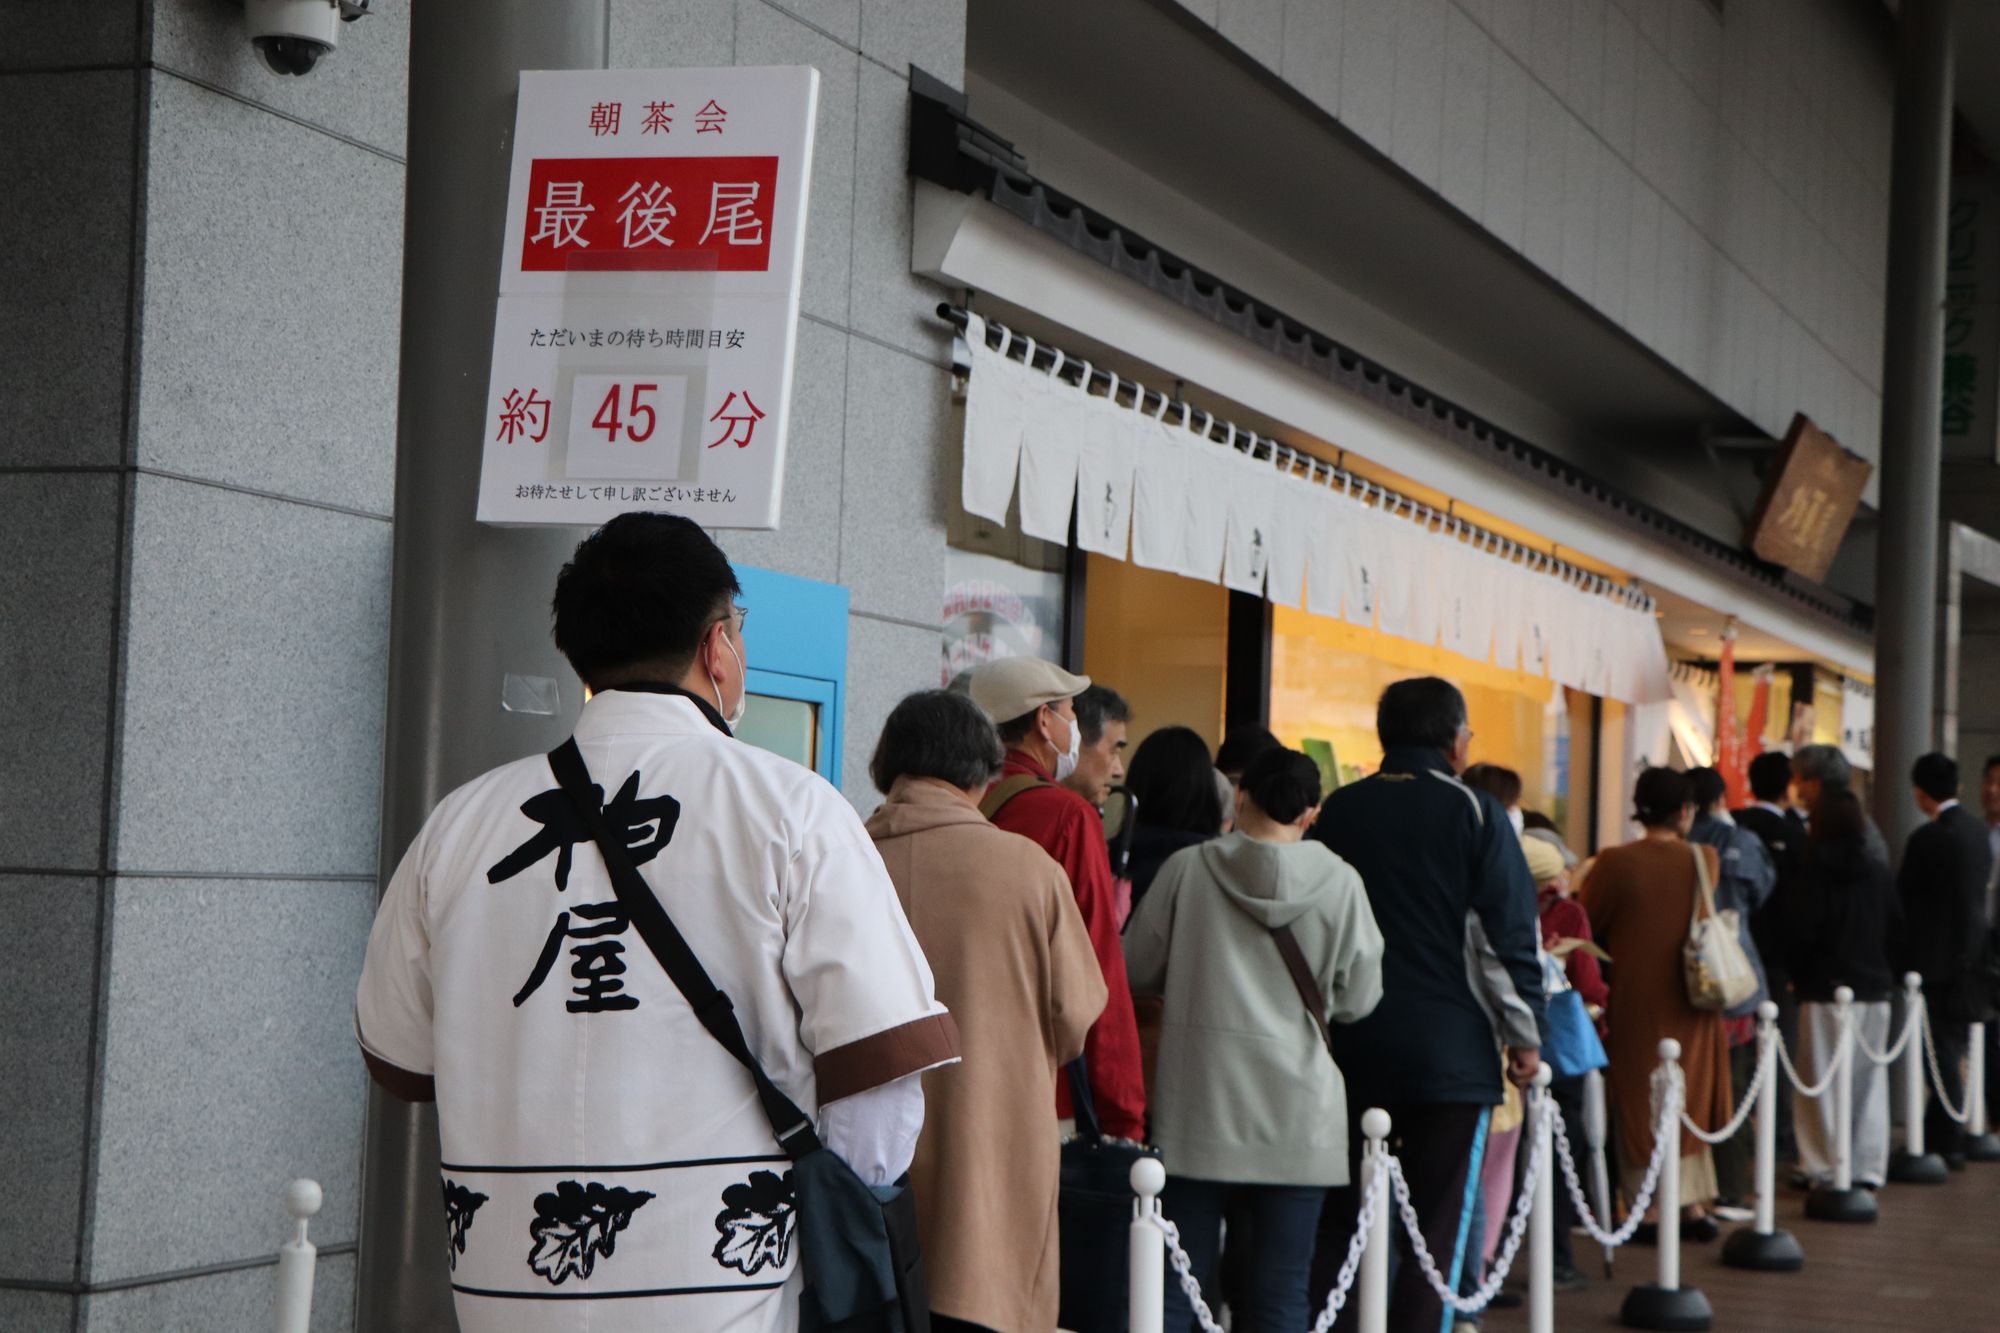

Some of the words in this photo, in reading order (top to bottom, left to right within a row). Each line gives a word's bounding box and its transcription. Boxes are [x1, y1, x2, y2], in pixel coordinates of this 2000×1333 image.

[588, 99, 728, 135] 朝茶会
[529, 180, 764, 249] 最後尾
[529, 328, 746, 350] ただいまの待ち時間目安
[496, 387, 551, 445] 約
[591, 383, 658, 443] 45
[707, 390, 767, 449] 分
[515, 484, 737, 504] お待たせして申し訳ございません
[487, 769, 681, 1013] 柏屋
